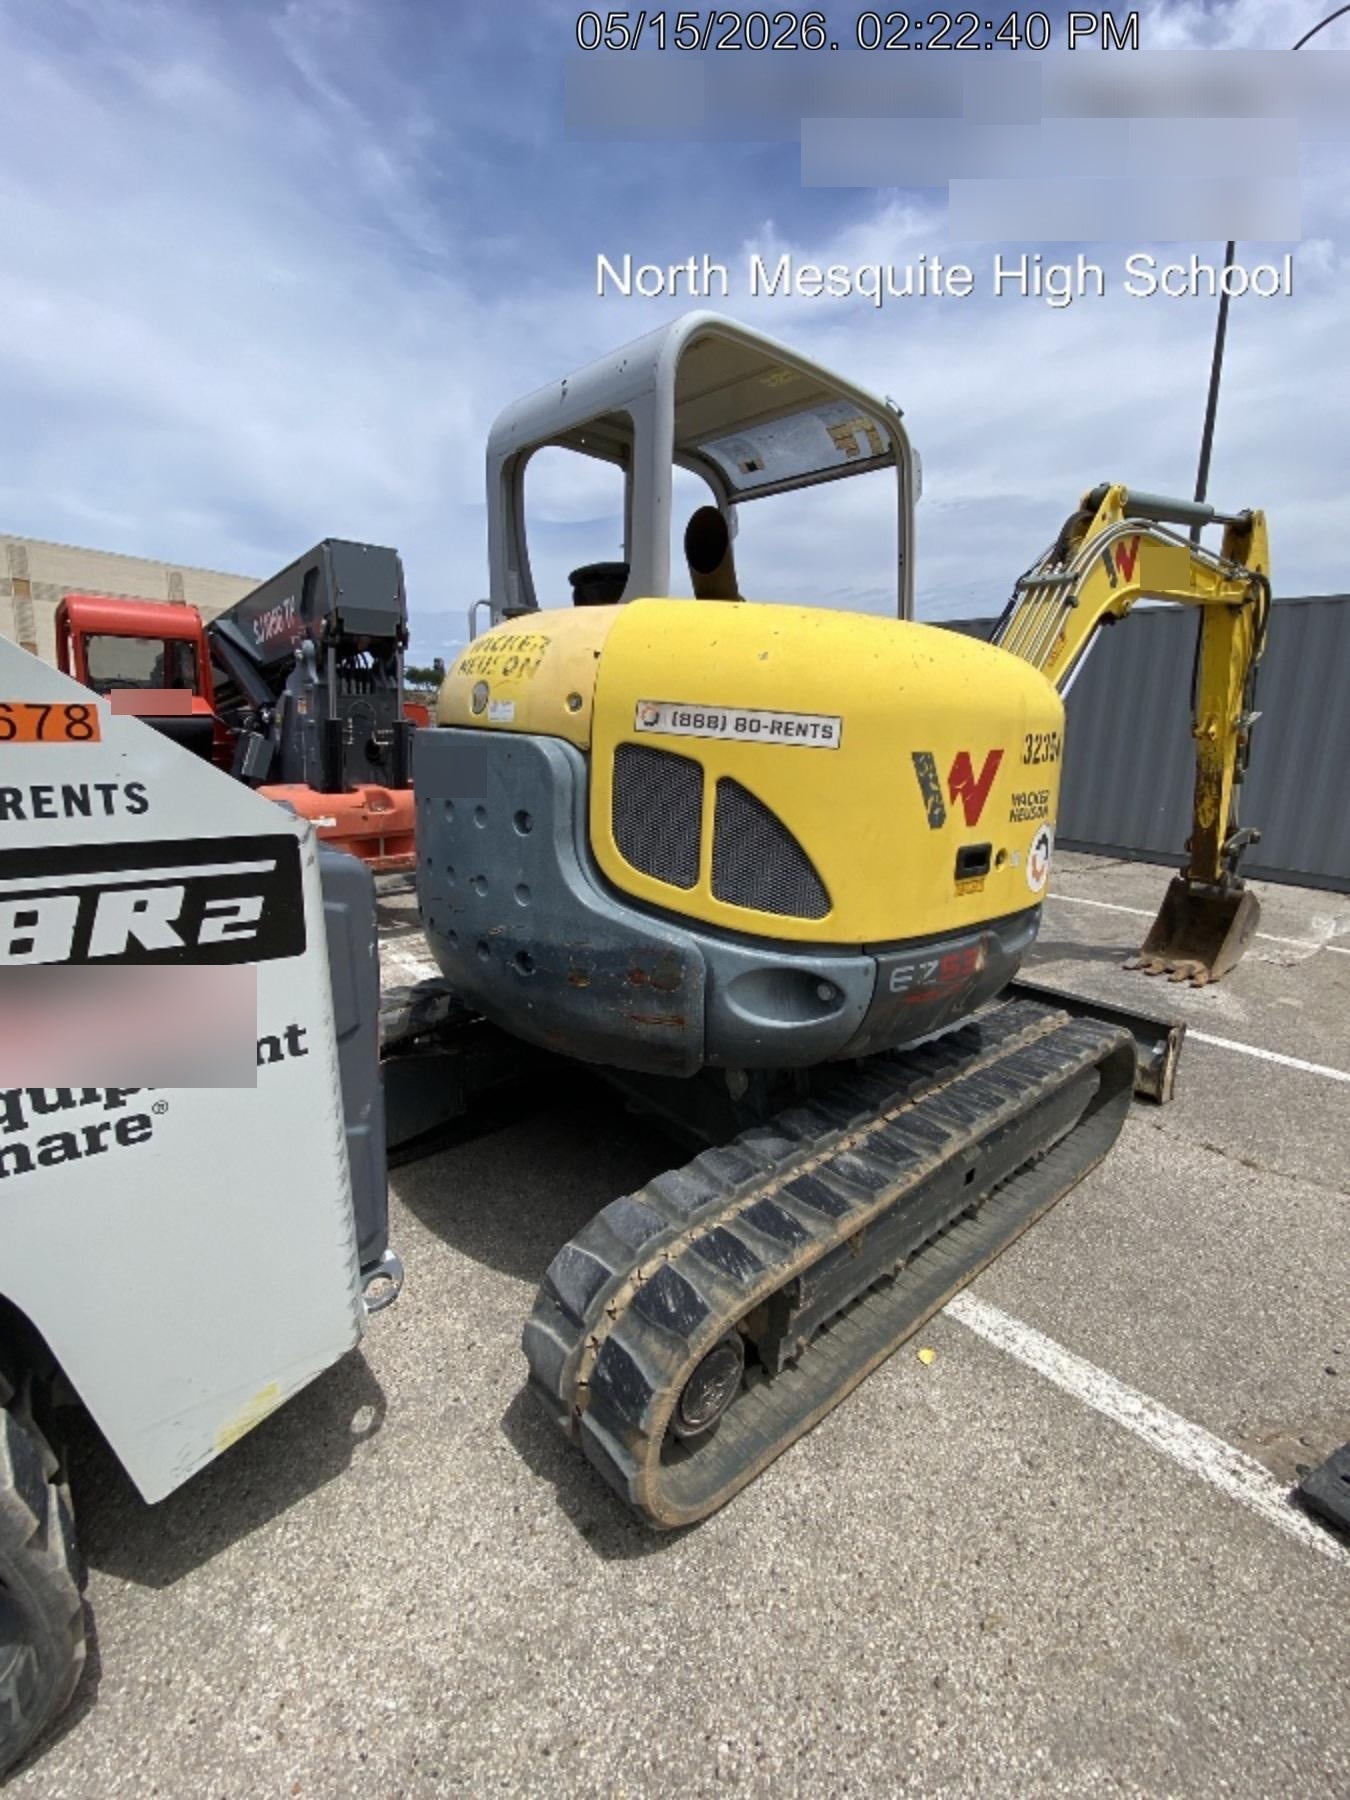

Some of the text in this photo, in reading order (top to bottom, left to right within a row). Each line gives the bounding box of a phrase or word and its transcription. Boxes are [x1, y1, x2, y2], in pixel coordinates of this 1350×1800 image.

[671, 711, 834, 740] (888) 80-RENTS
[0, 782, 149, 820] RENTS
